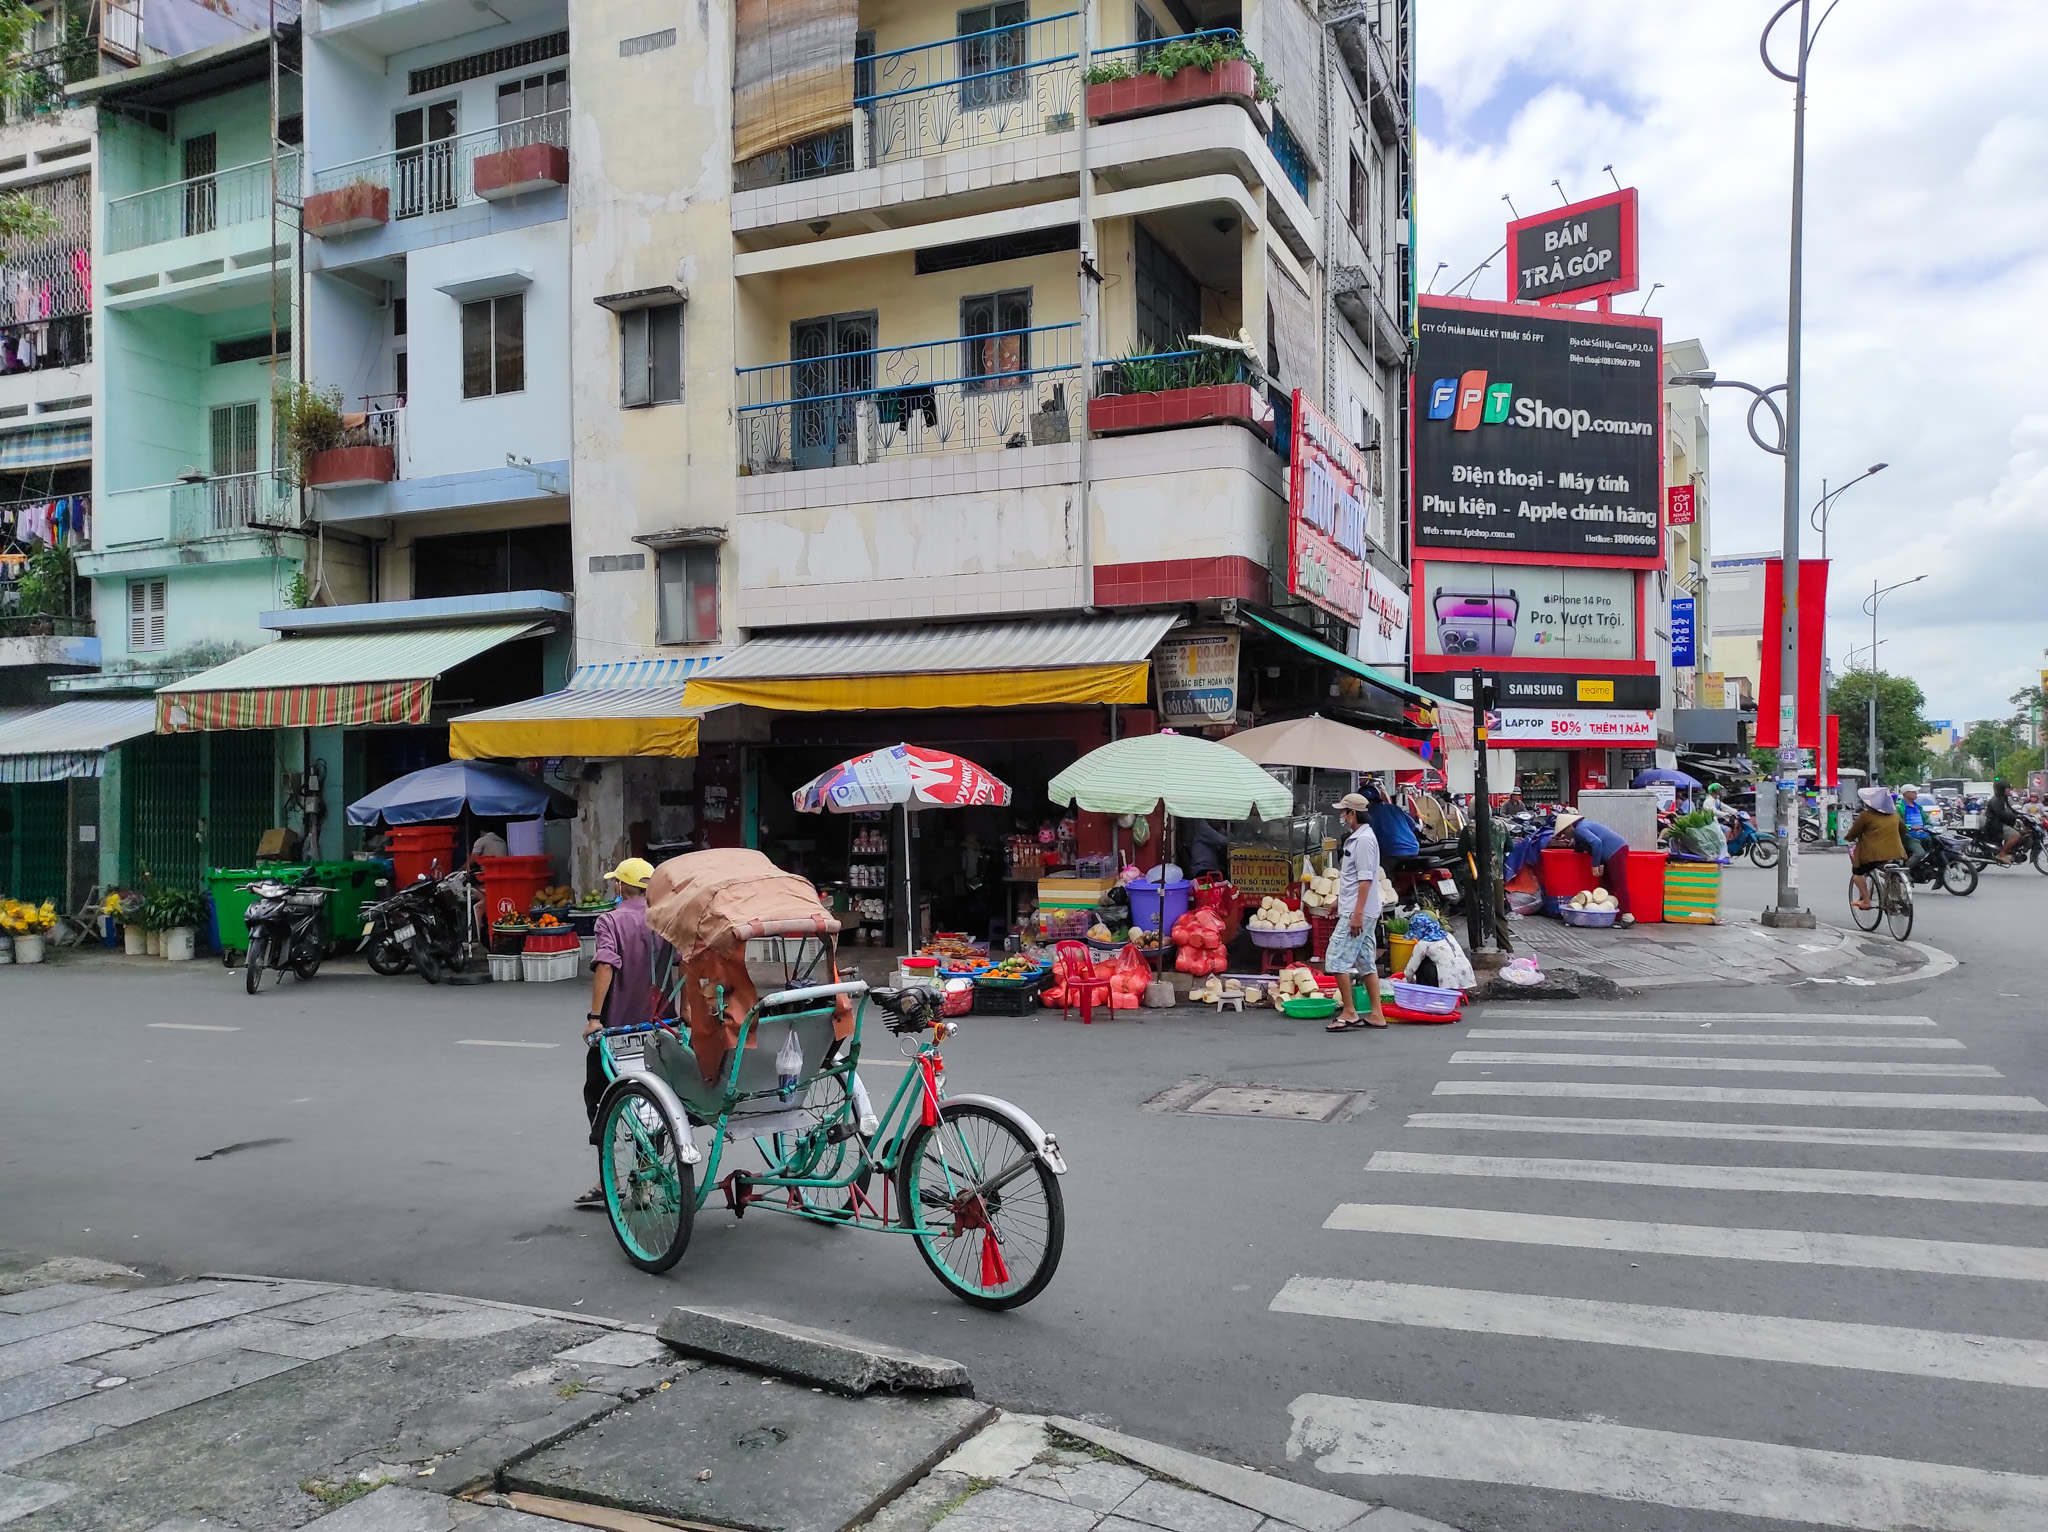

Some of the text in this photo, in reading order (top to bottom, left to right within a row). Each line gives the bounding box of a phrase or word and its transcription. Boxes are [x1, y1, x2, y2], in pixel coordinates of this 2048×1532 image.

[1544, 221, 1588, 252] BÁN
[1522, 247, 1612, 289] TRẢ GÓP
[1422, 324, 1436, 332] CTY
[1466, 326, 1480, 336] BÁN
[1532, 334, 1544, 342] FPT
[1451, 465, 1495, 488] Điện
[1497, 467, 1543, 491] thoại
[1558, 472, 1594, 495] Máy
[1597, 473, 1630, 493] tính
[1422, 495, 1456, 518] Phụ
[1458, 496, 1497, 520] kiện
[1517, 501, 1567, 523] Apple
[1570, 502, 1614, 523] chính
[1616, 506, 1658, 529] hãng
[1673, 502, 1689, 512] 01
[1614, 534, 1657, 546] 18006606
[1550, 595, 1612, 606] iPhone 14 Pro
[1531, 611, 1624, 629] Pro. Vượt Trội.
[1672, 636, 1690, 644] UỐC
[1180, 644, 1234, 660] 2.00.000
[1508, 684, 1563, 696] SAMSUNG
[1581, 685, 1610, 696] realme
[1182, 692, 1193, 713] SỐ
[1194, 694, 1229, 713] TRÚNG
[1505, 719, 1544, 727] LAPTOP
[1551, 720, 1582, 733] 50%
[1589, 722, 1617, 733] THÊM
[1626, 722, 1649, 732] NĂM
